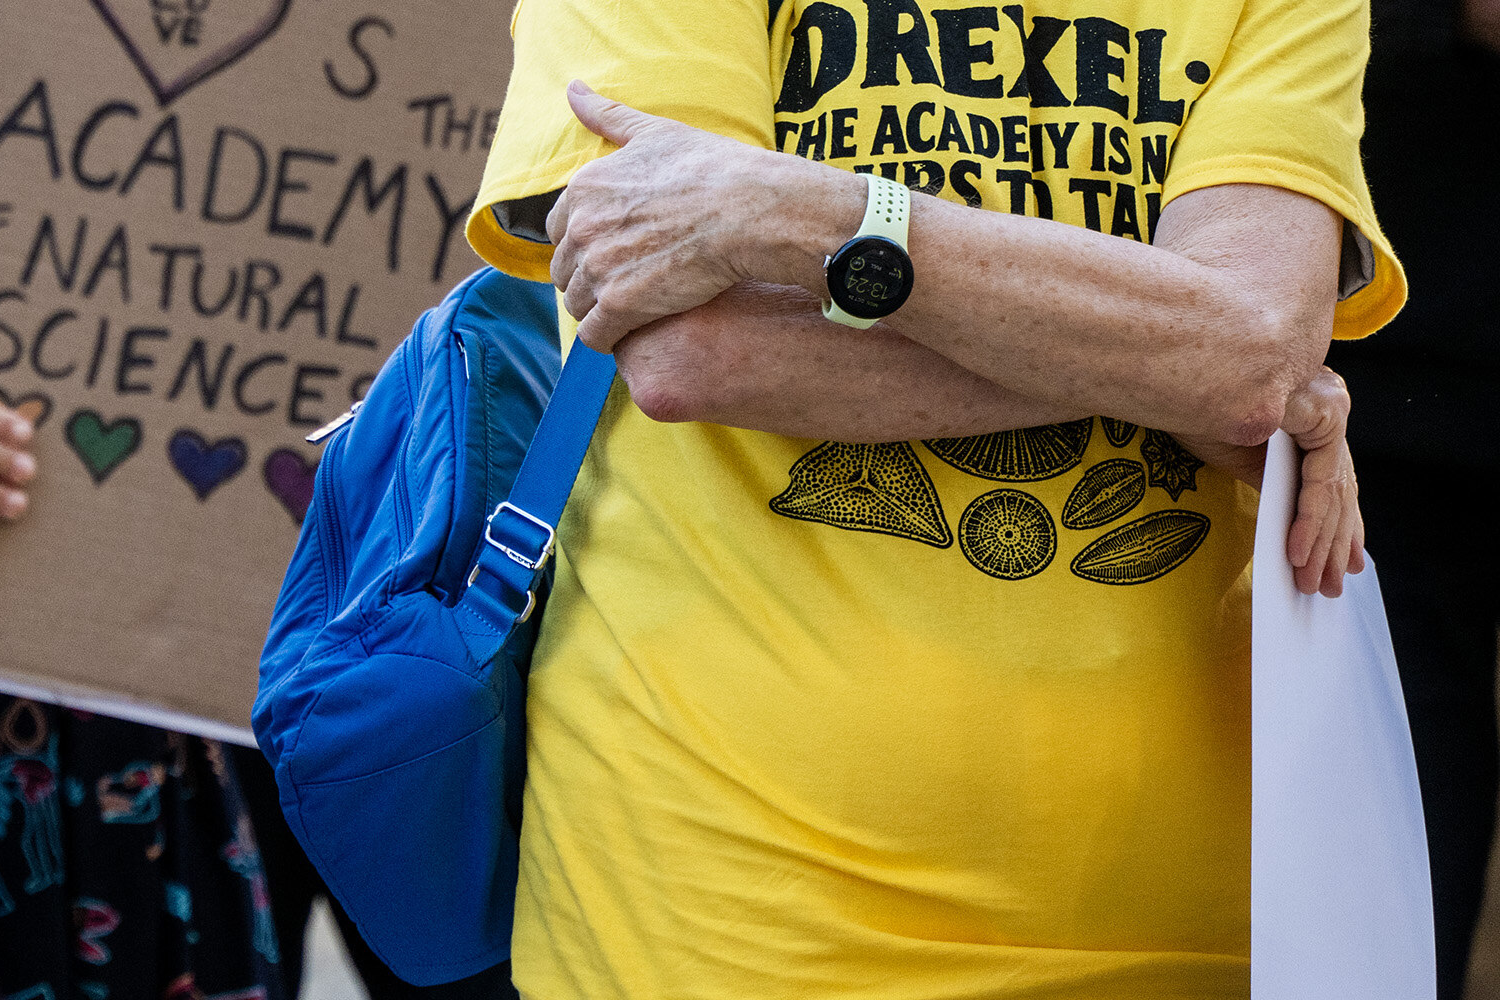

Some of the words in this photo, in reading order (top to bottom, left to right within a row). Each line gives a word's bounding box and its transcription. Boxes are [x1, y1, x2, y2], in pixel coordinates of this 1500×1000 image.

[775, 107, 859, 162] THE
[1090, 121, 1133, 175] IS
[20, 213, 379, 349] NATURAL
[846, 274, 889, 300] 13:24
